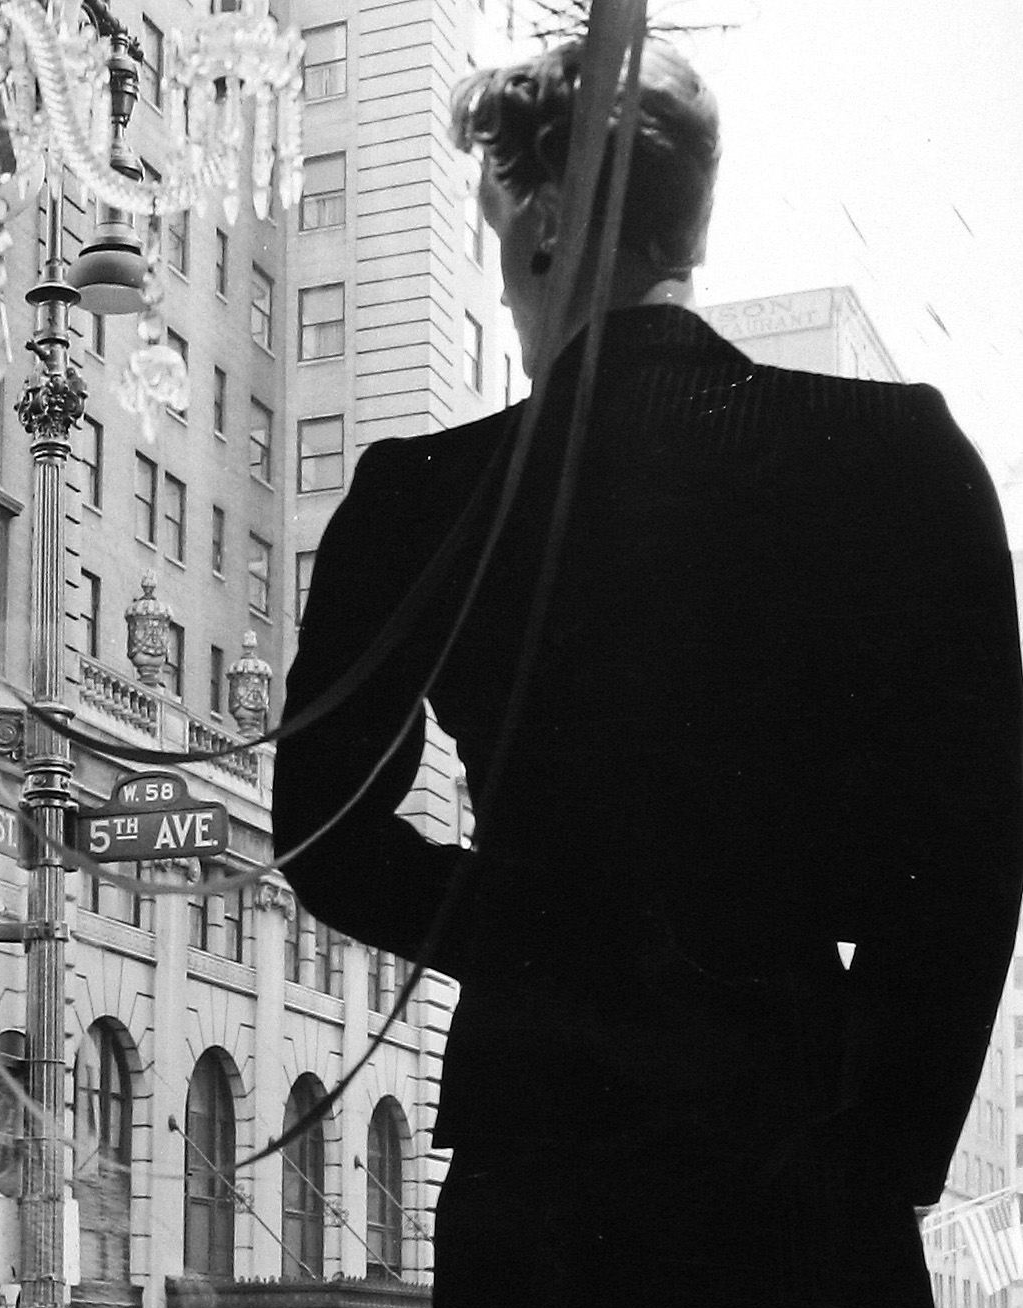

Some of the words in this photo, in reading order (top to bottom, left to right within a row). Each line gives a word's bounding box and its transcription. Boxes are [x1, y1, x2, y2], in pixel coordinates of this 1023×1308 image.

[719, 309, 818, 335] TAURANT
[123, 785, 140, 802] W.
[145, 782, 174, 800] 58
[89, 818, 139, 854] 5TH
[154, 812, 219, 850] AVE.
